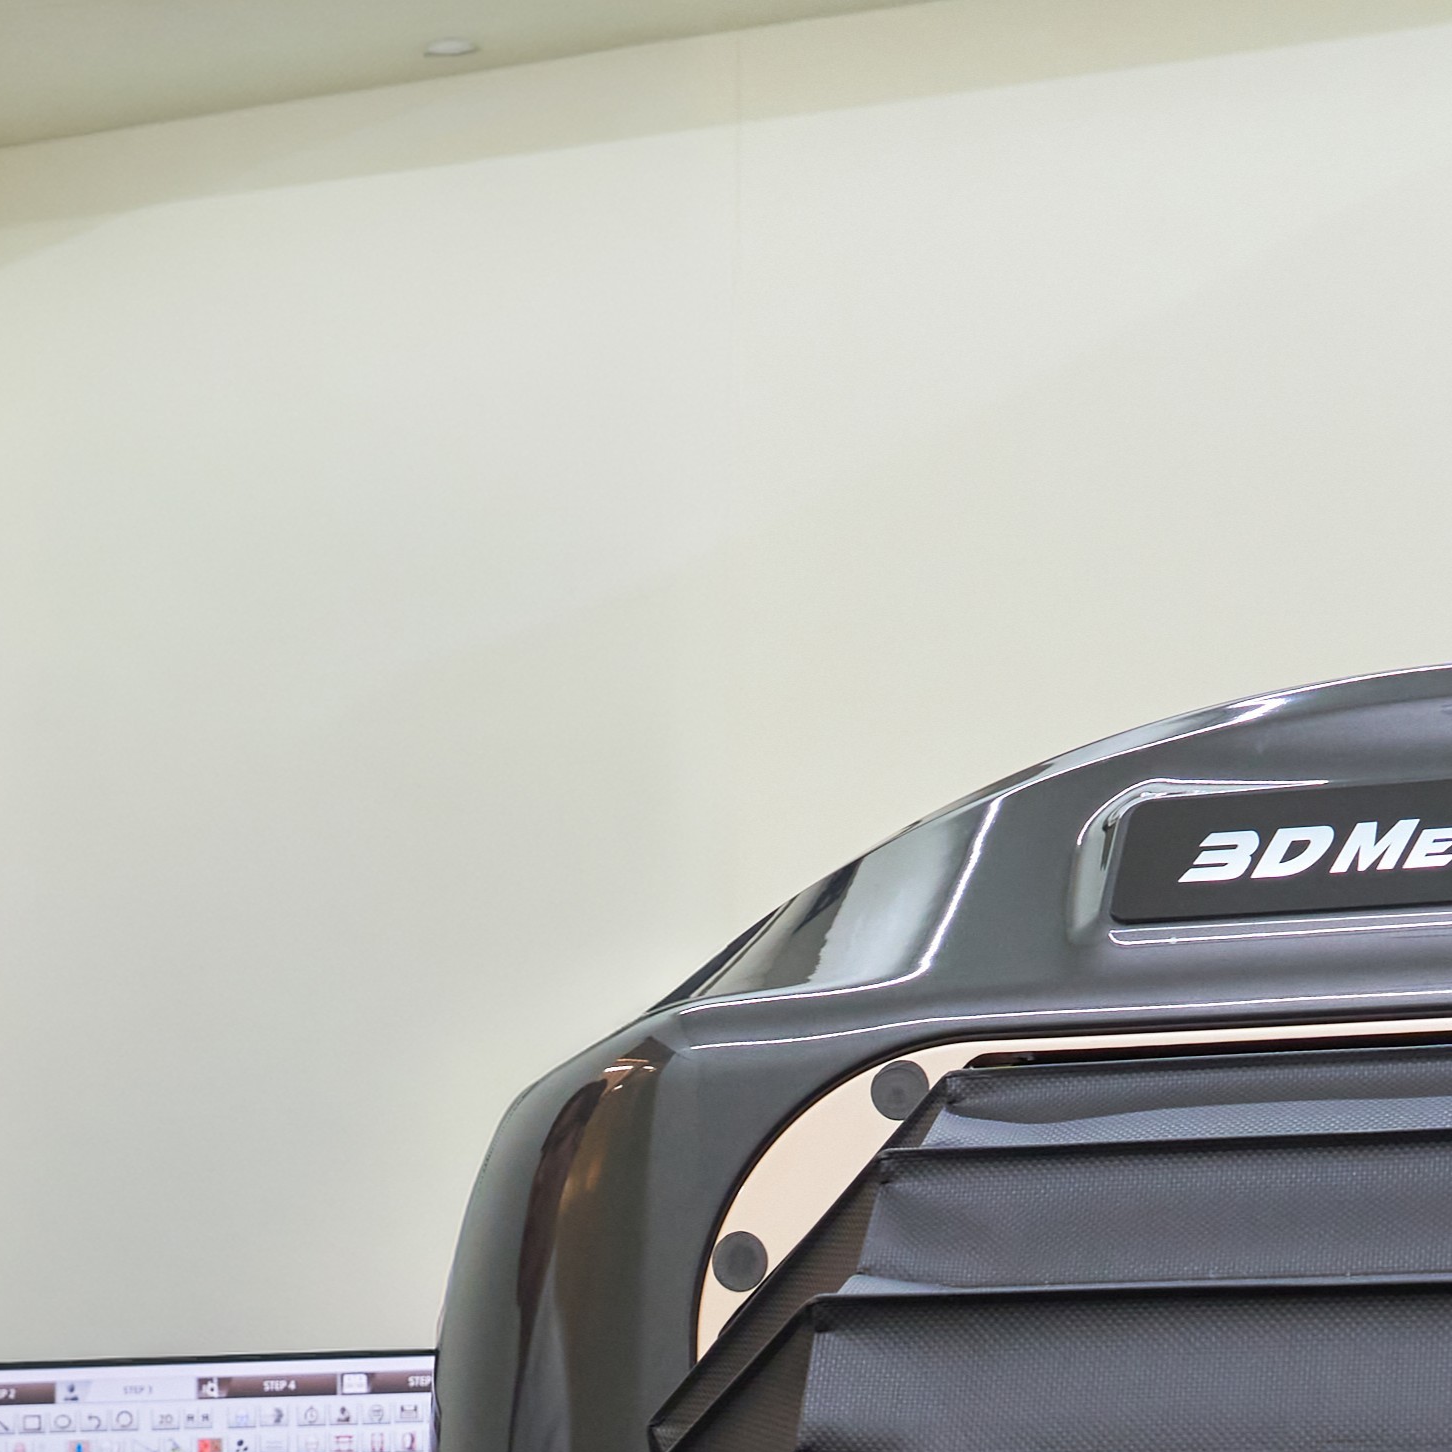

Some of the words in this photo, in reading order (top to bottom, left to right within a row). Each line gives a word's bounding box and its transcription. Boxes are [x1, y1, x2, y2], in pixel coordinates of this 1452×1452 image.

[263, 1380, 286, 1391] STEP
[287, 1380, 296, 1390] 4
[408, 1375, 432, 1387] STEP
[123, 1385, 145, 1395] STEP
